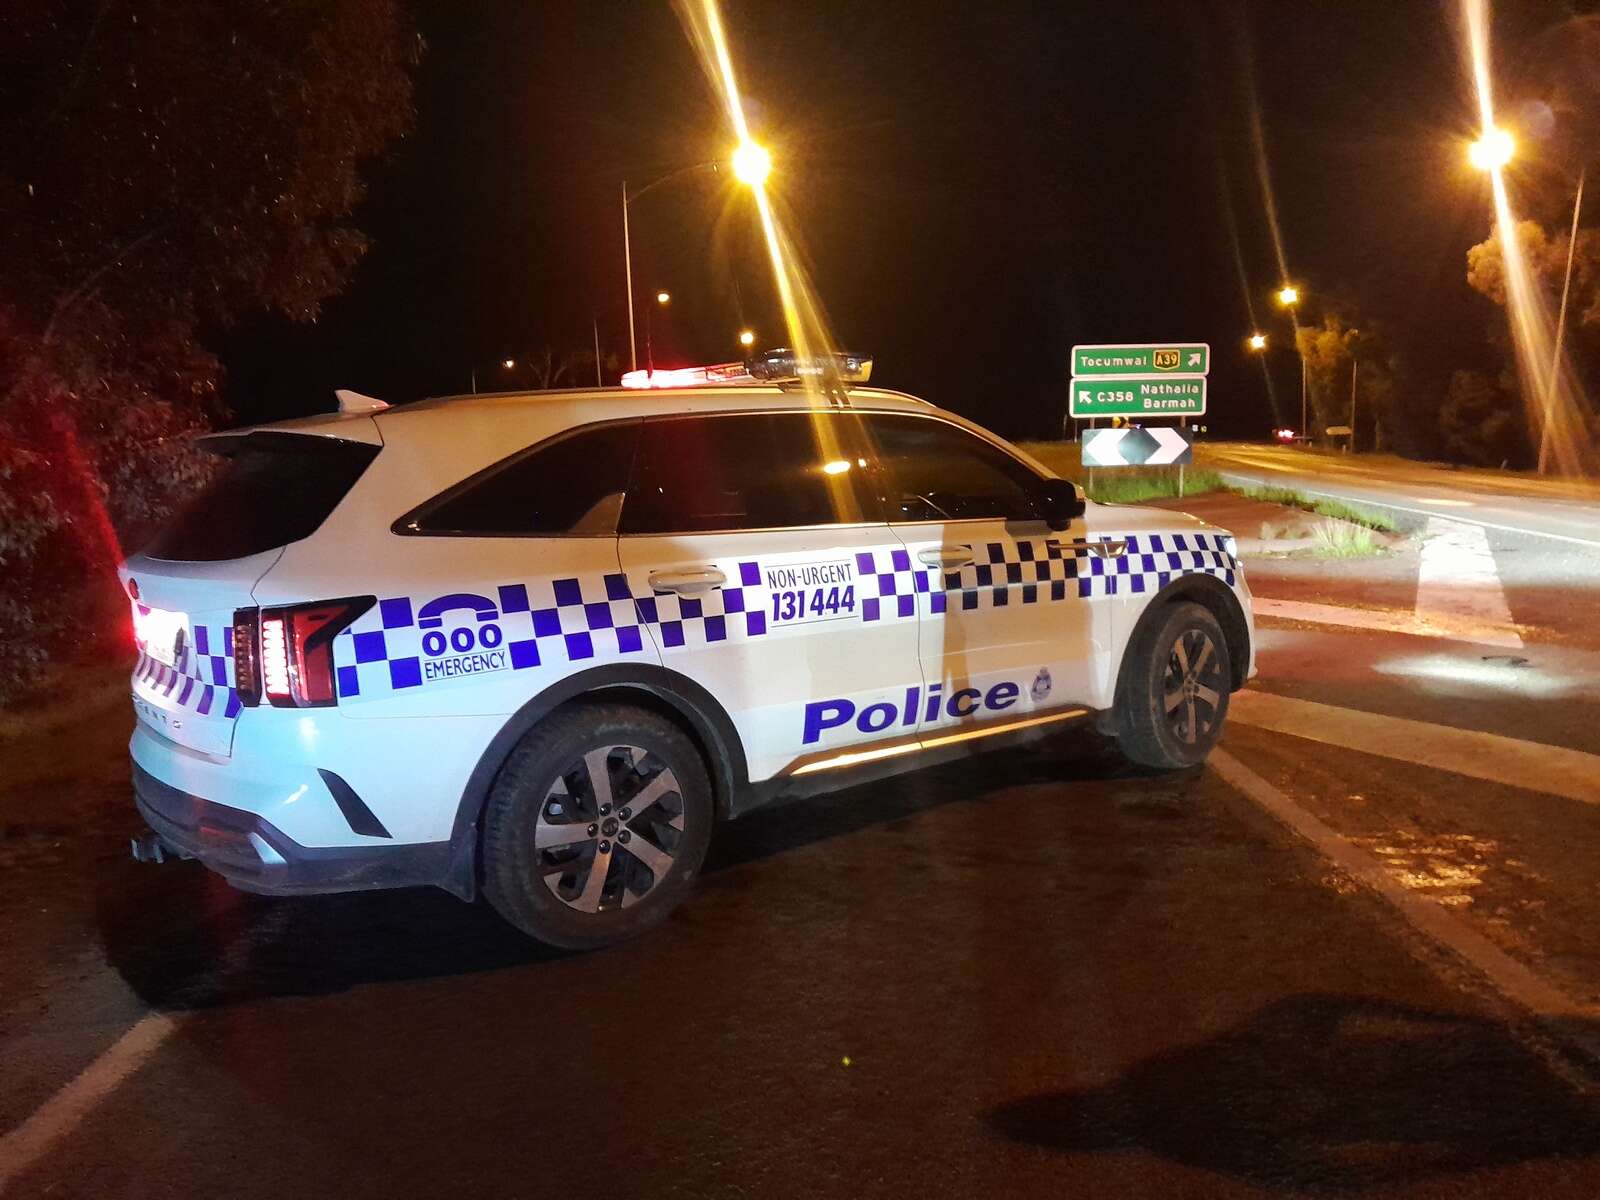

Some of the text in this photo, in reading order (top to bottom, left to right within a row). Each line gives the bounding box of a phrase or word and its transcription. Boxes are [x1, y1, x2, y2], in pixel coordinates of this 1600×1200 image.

[1080, 354, 1178, 367] Tocumwal A39
[1097, 391, 1133, 402] C358
[1141, 384, 1199, 394] Nathalia
[1143, 398, 1196, 408] Barmah
[767, 563, 852, 589] NON-URGENT
[422, 623, 503, 657] 000
[424, 651, 506, 679] EMERGENCY
[802, 681, 1020, 745] Police
